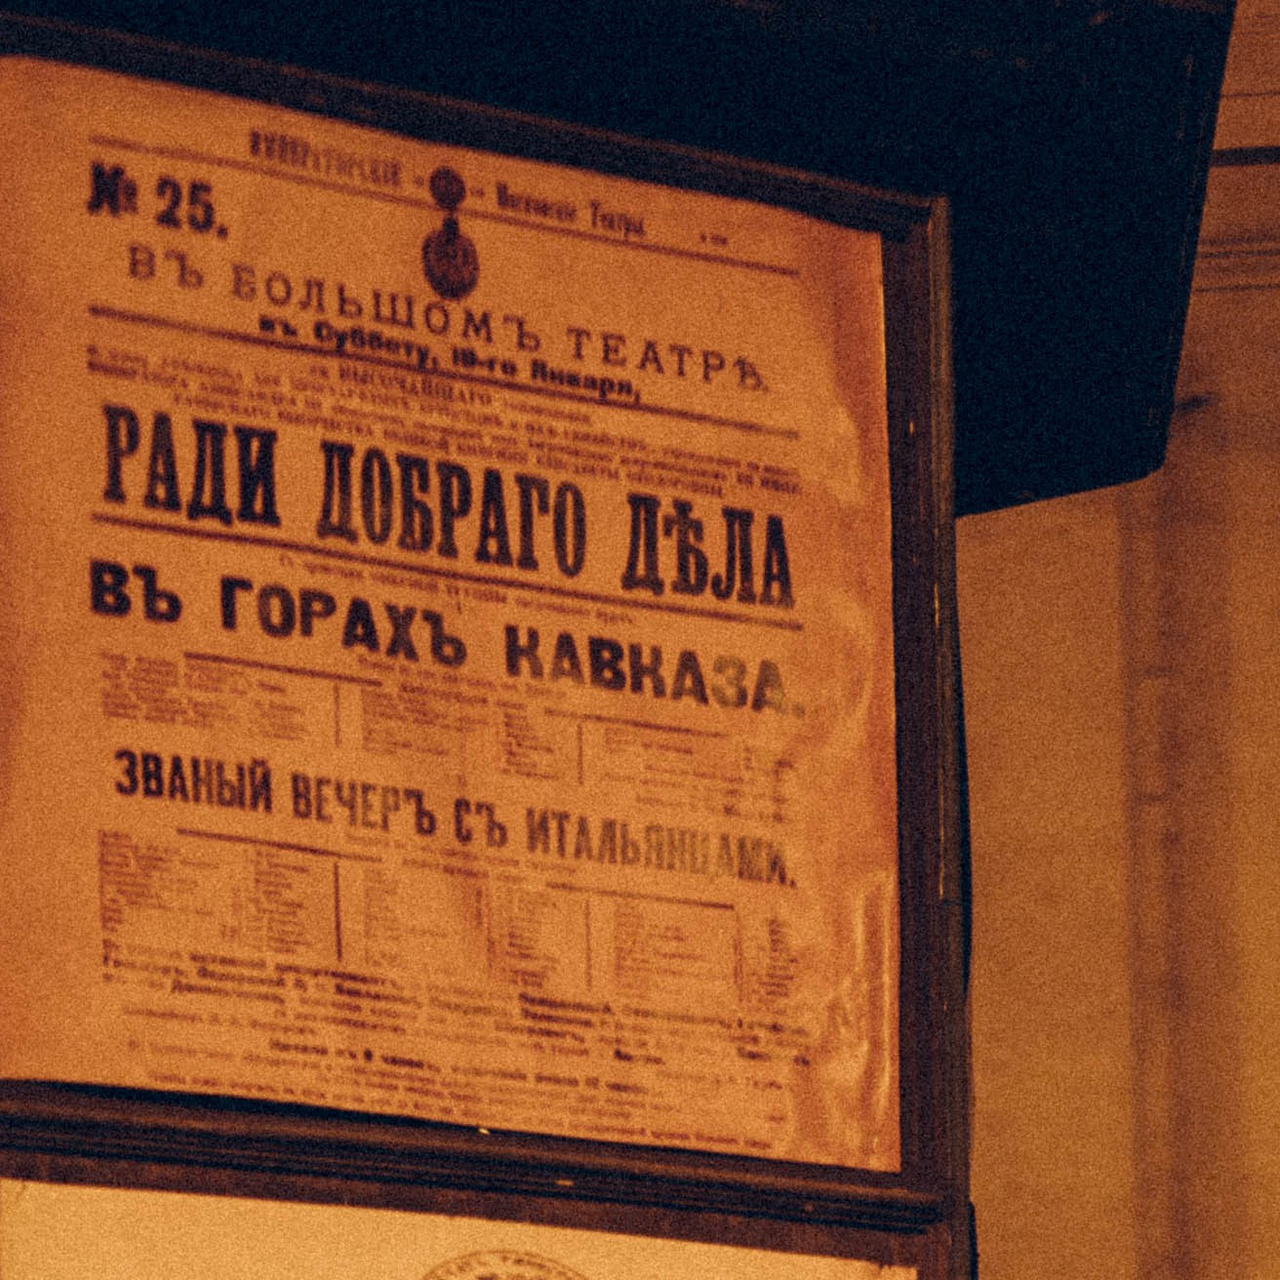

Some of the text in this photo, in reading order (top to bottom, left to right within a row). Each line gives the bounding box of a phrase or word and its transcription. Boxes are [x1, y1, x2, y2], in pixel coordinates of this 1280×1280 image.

[155, 175, 229, 241] 25.
[128, 243, 205, 288] ВЪ
[234, 263, 542, 352] БОЛЬШОМЪ
[103, 402, 282, 528] РАДИ
[317, 439, 587, 579] ДОБРАГО
[621, 490, 797, 609] ДѢЛА
[90, 559, 183, 623] ВЪ
[219, 574, 468, 669] ГОРАХЪ
[114, 749, 273, 815] ЗВАНЫЙ
[291, 771, 437, 838] ВЕЧЕРЪ
[454, 798, 509, 848] СЪ
